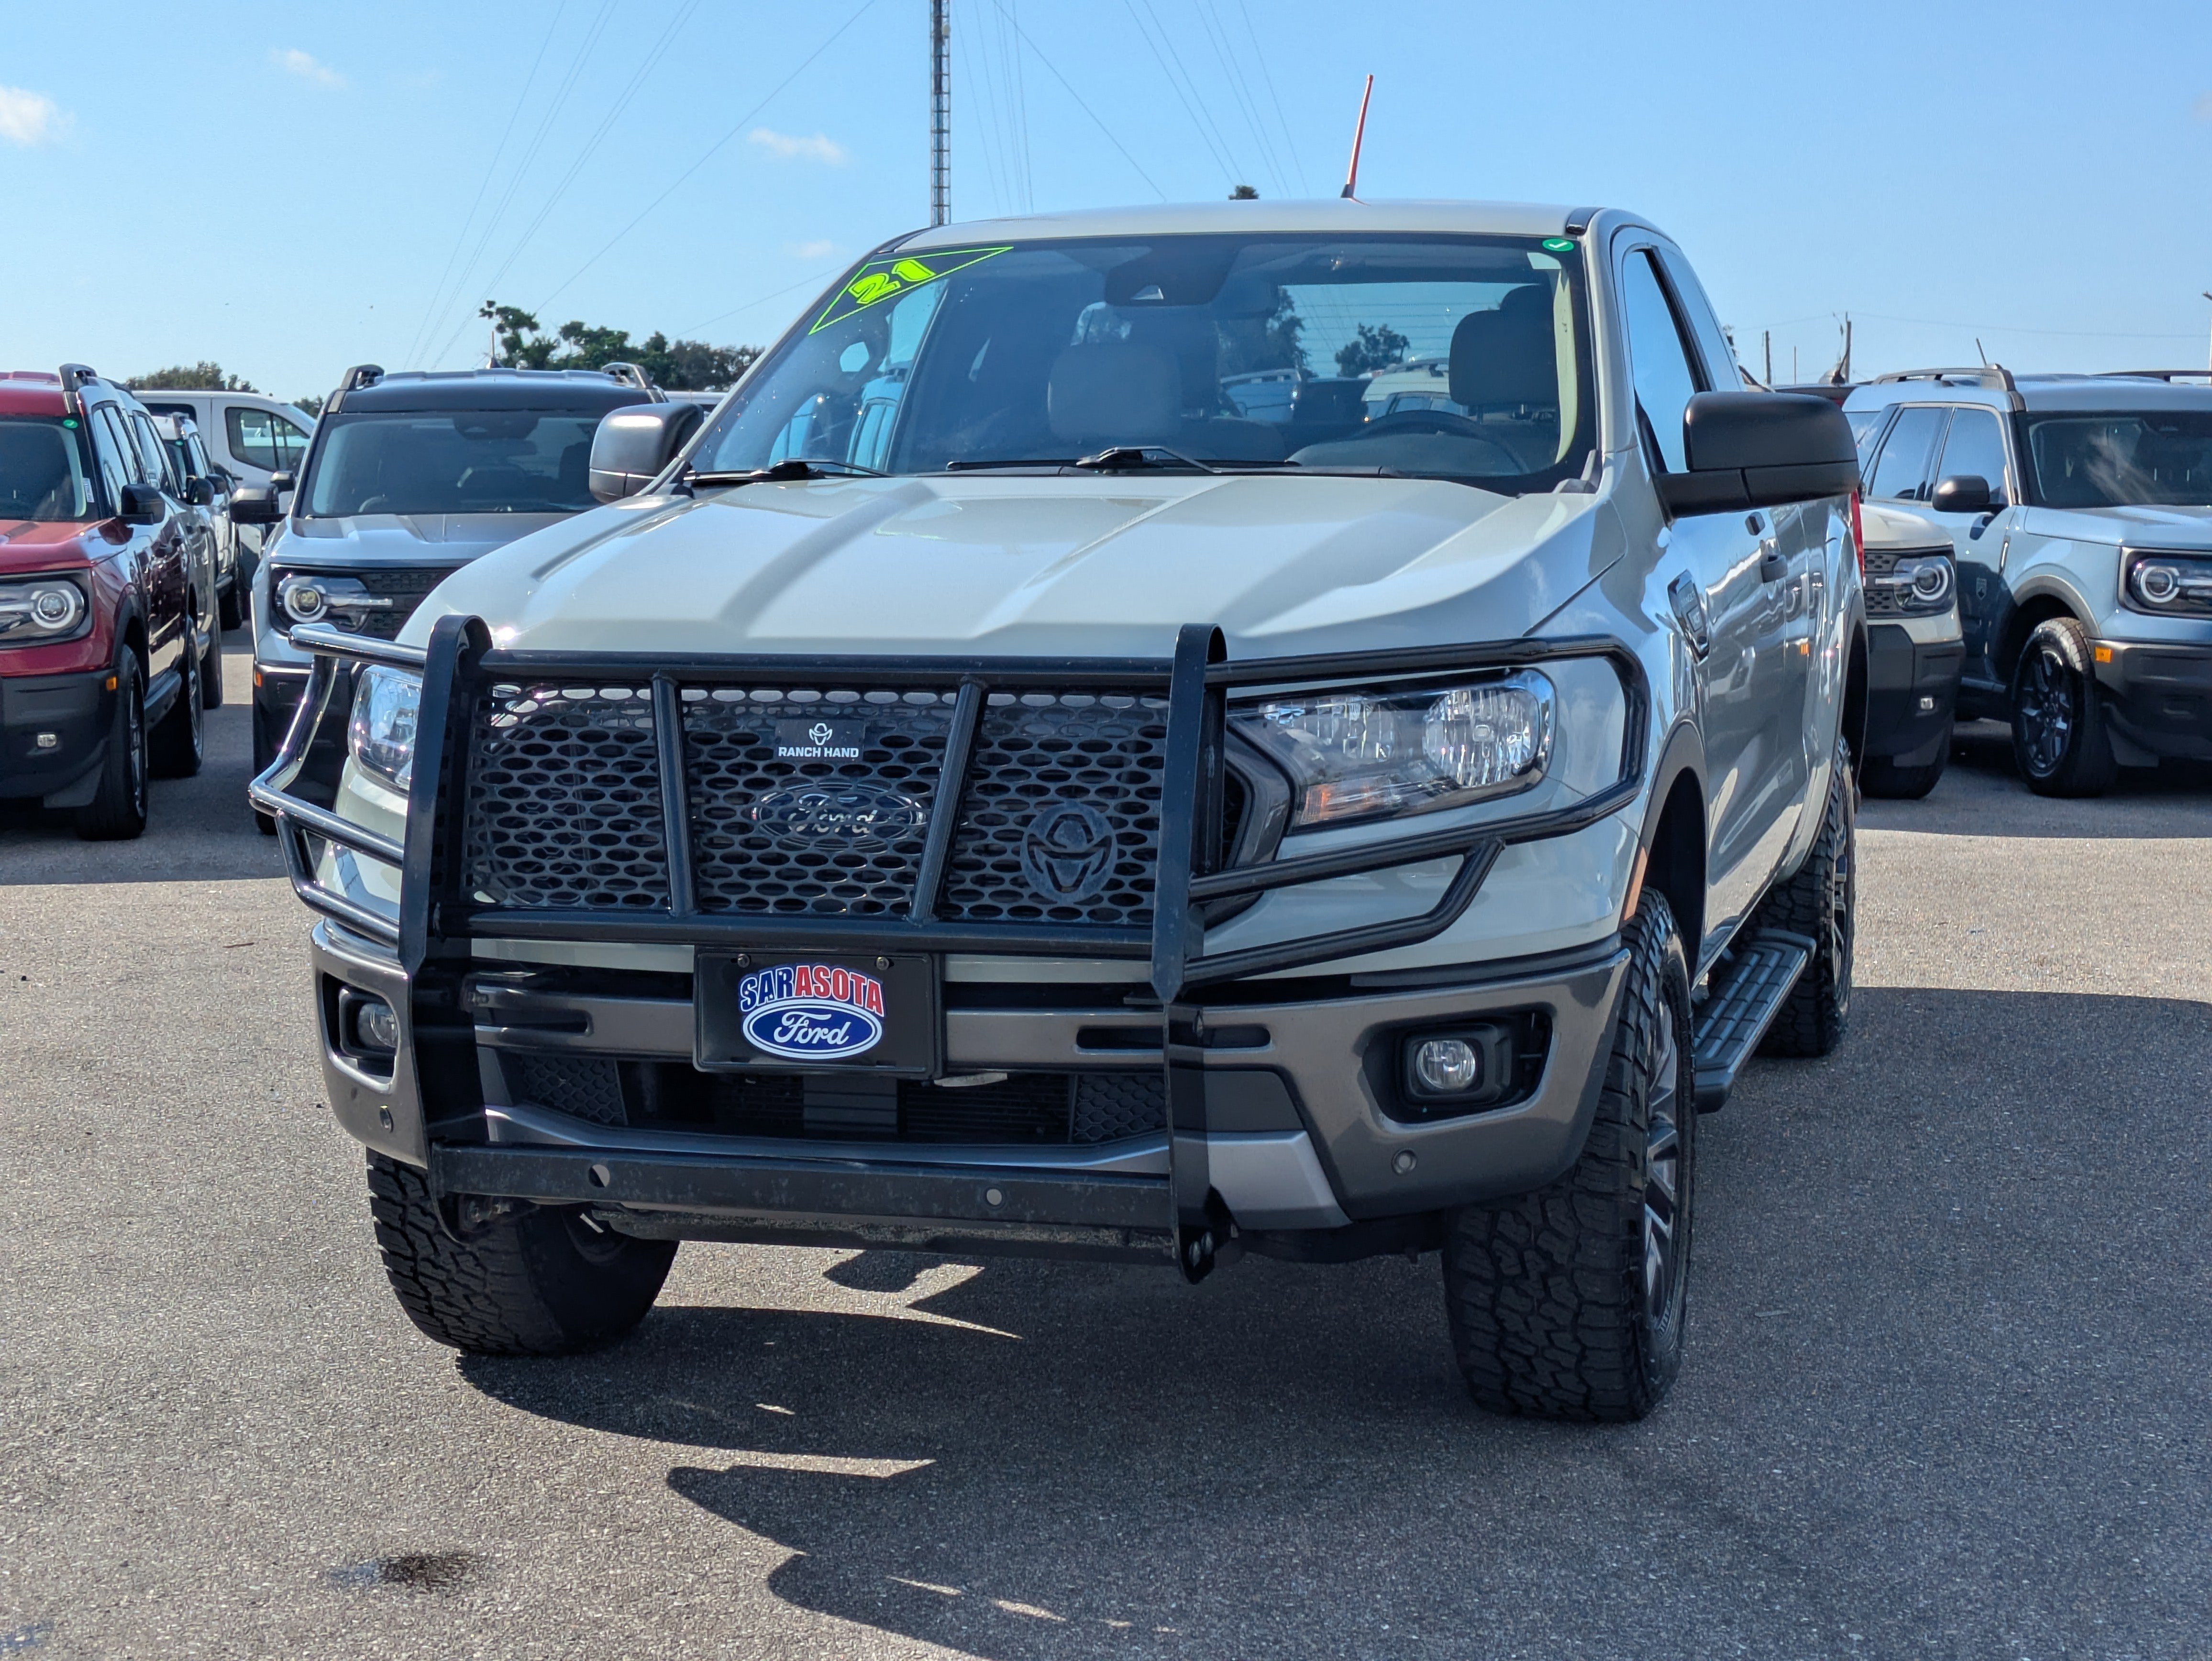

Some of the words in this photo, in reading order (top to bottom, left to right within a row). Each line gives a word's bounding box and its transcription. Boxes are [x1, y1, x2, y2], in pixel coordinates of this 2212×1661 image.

[848, 259, 936, 304] 21
[778, 746, 821, 757] RANCH
[824, 747, 859, 758] HAND
[740, 965, 885, 1017] SARASOTA
[774, 1011, 852, 1045] Ford
